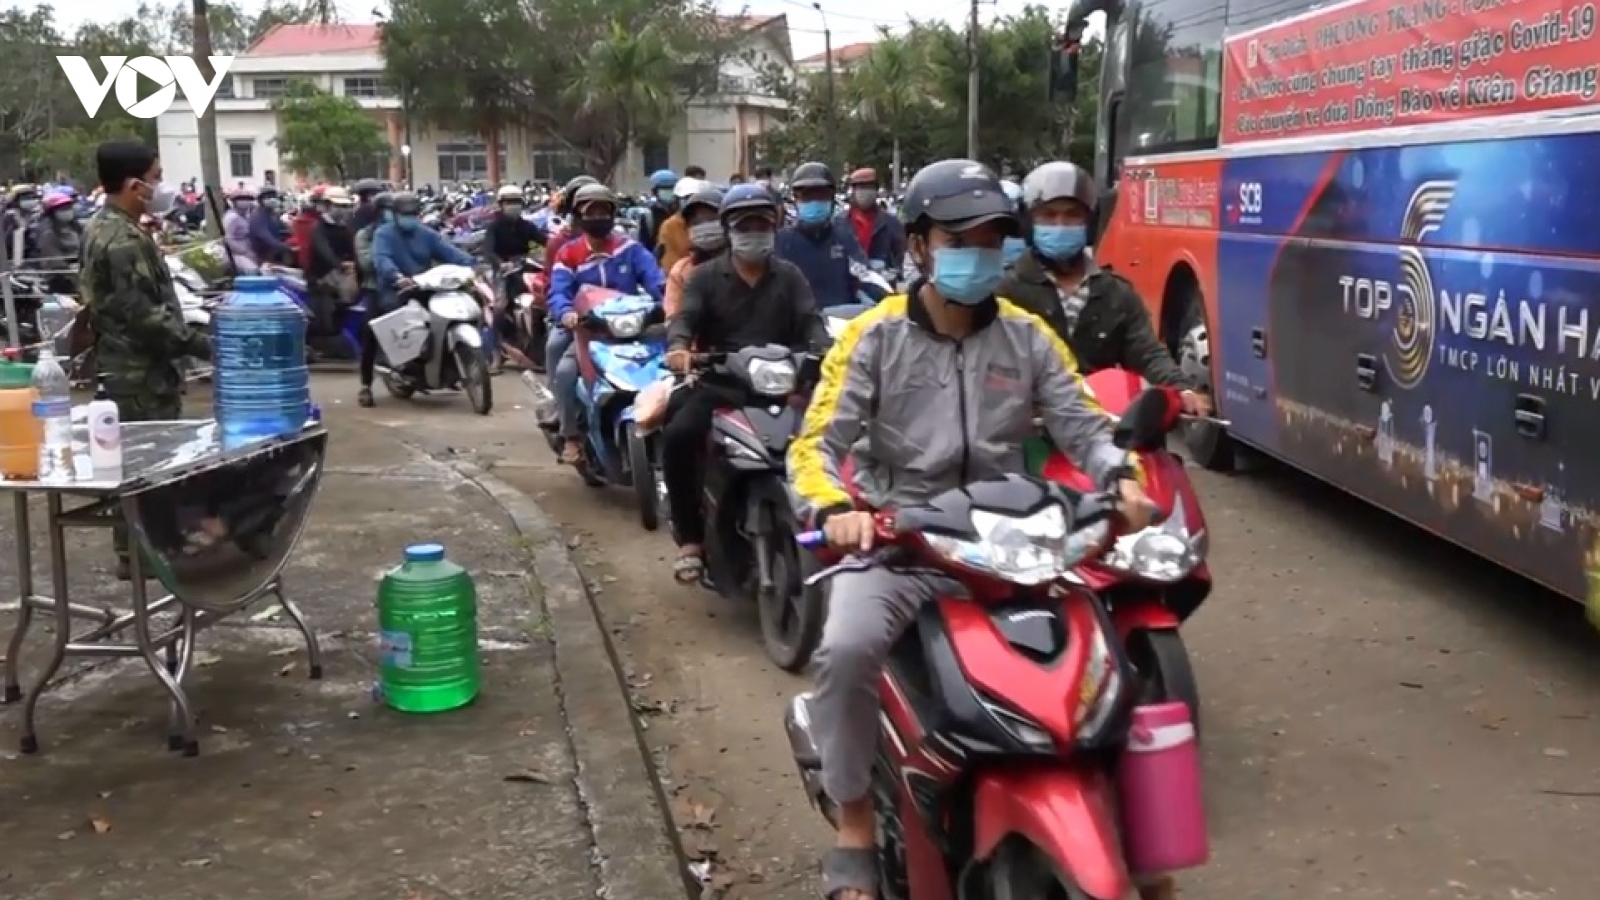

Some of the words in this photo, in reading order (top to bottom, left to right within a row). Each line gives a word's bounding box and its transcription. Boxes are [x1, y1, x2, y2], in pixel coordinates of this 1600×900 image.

[1321, 61, 1366, 88] chung
[1370, 55, 1397, 83] tay
[1510, 2, 1596, 54] Covid-19
[1465, 72, 1516, 108] Kiên
[1524, 65, 1598, 100] Giang
[1239, 182, 1262, 213] SCB
[1339, 275, 1393, 319] TOP
[1439, 344, 1479, 371] TMCP
